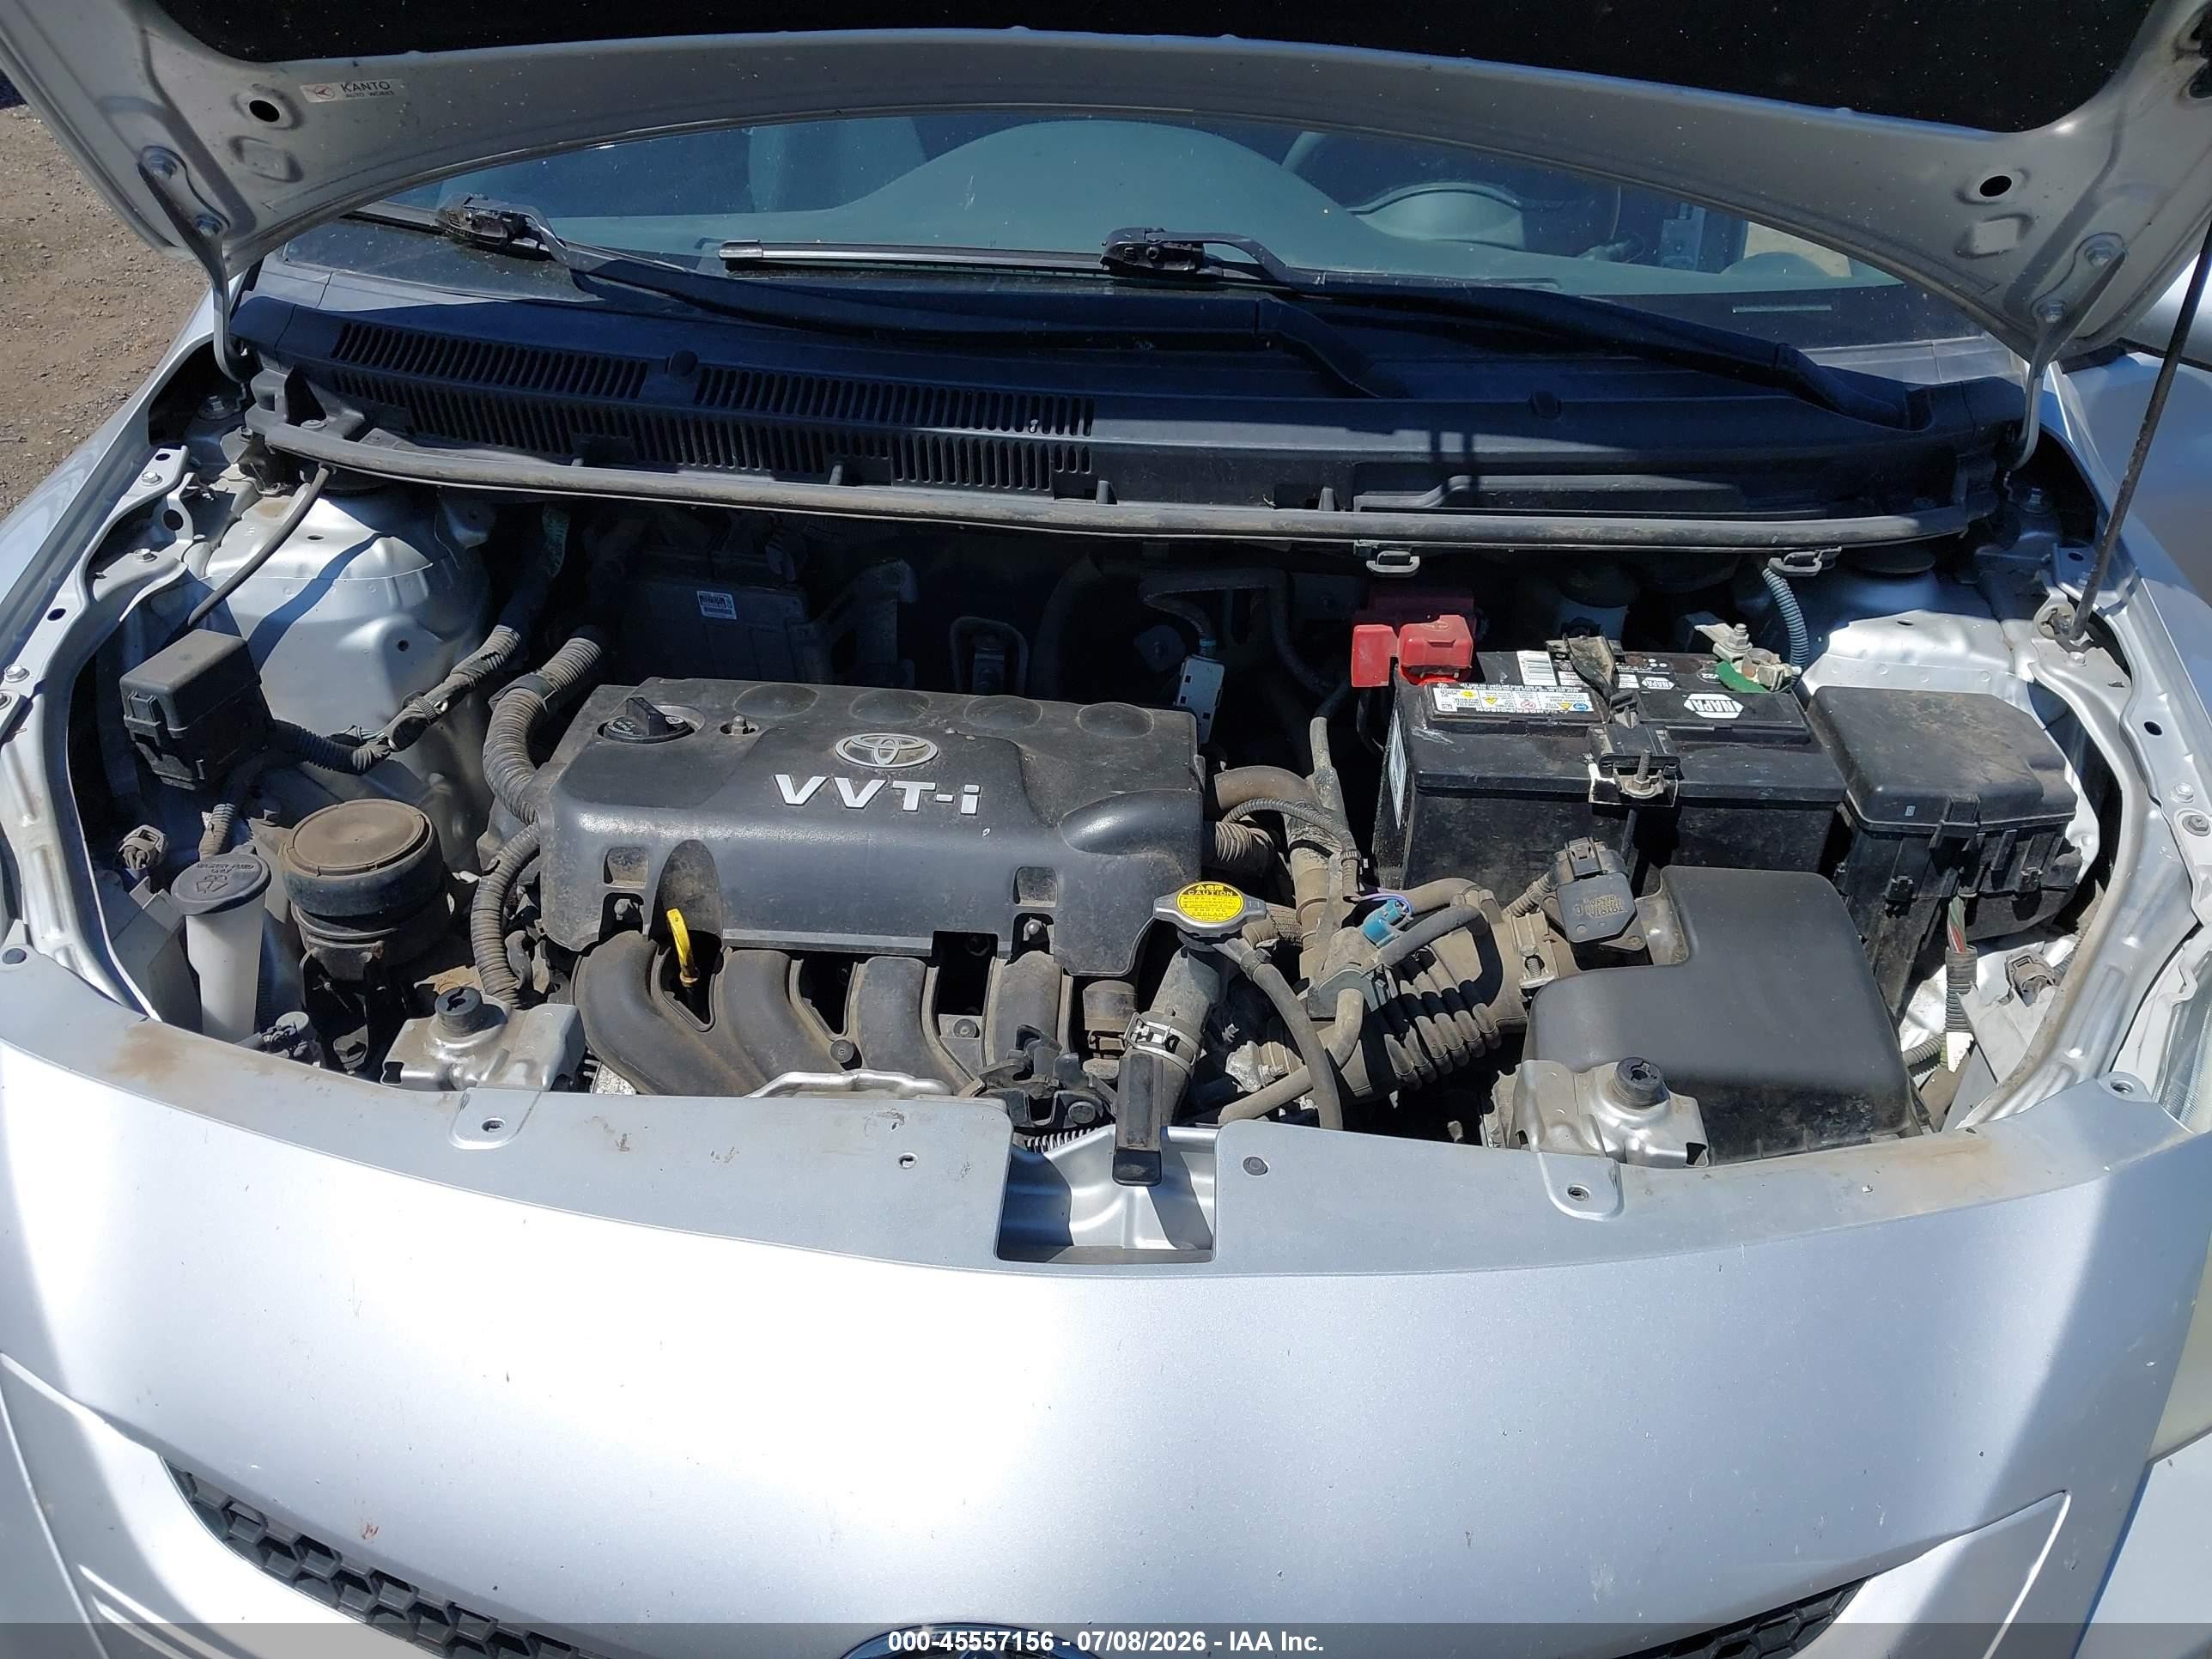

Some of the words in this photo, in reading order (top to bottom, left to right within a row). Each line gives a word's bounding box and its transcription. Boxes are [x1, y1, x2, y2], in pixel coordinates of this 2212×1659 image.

[341, 81, 391, 92] KANTO
[1645, 679, 1671, 689] NAPA
[1691, 699, 1736, 713] NAPA
[775, 774, 981, 815] VVT-i
[1590, 906, 1624, 917] TOYOTA
